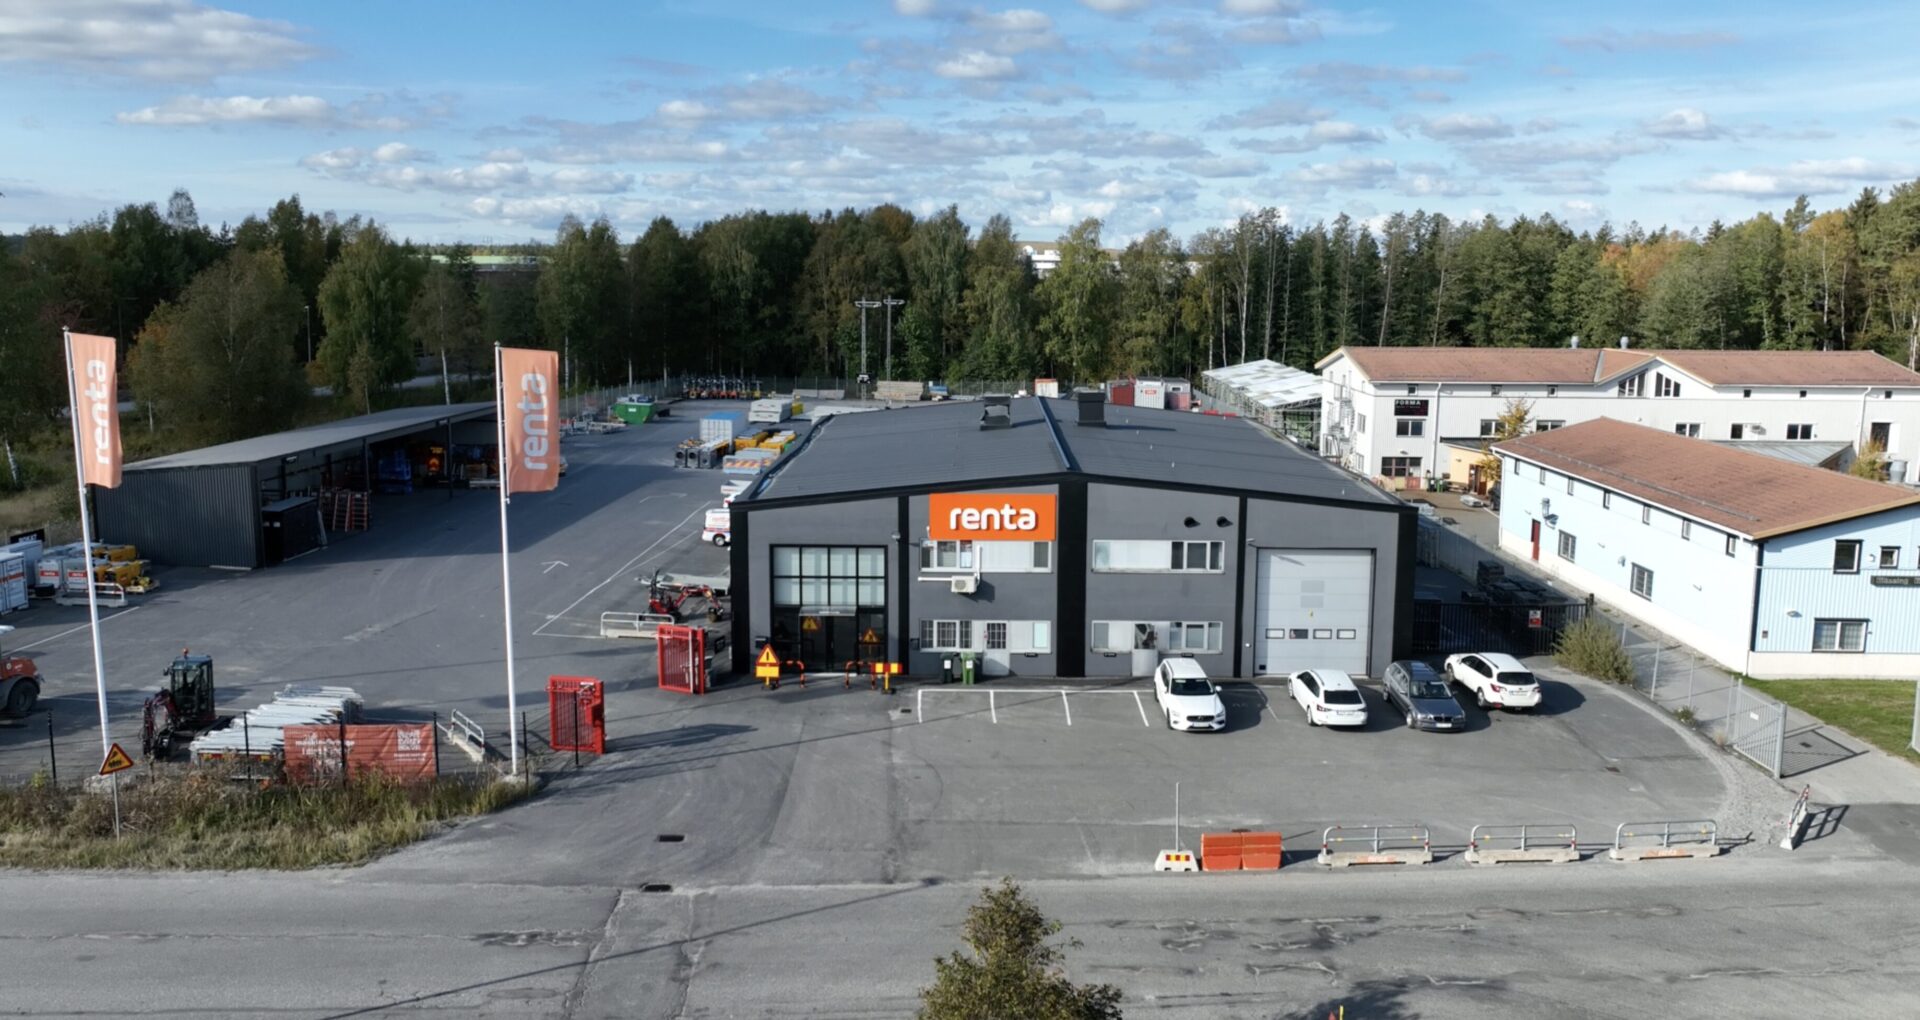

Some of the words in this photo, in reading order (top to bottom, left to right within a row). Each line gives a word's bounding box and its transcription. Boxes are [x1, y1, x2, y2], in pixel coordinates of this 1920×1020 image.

[84, 359, 110, 465] renta
[516, 372, 549, 470] renta
[949, 503, 1037, 531] renta
